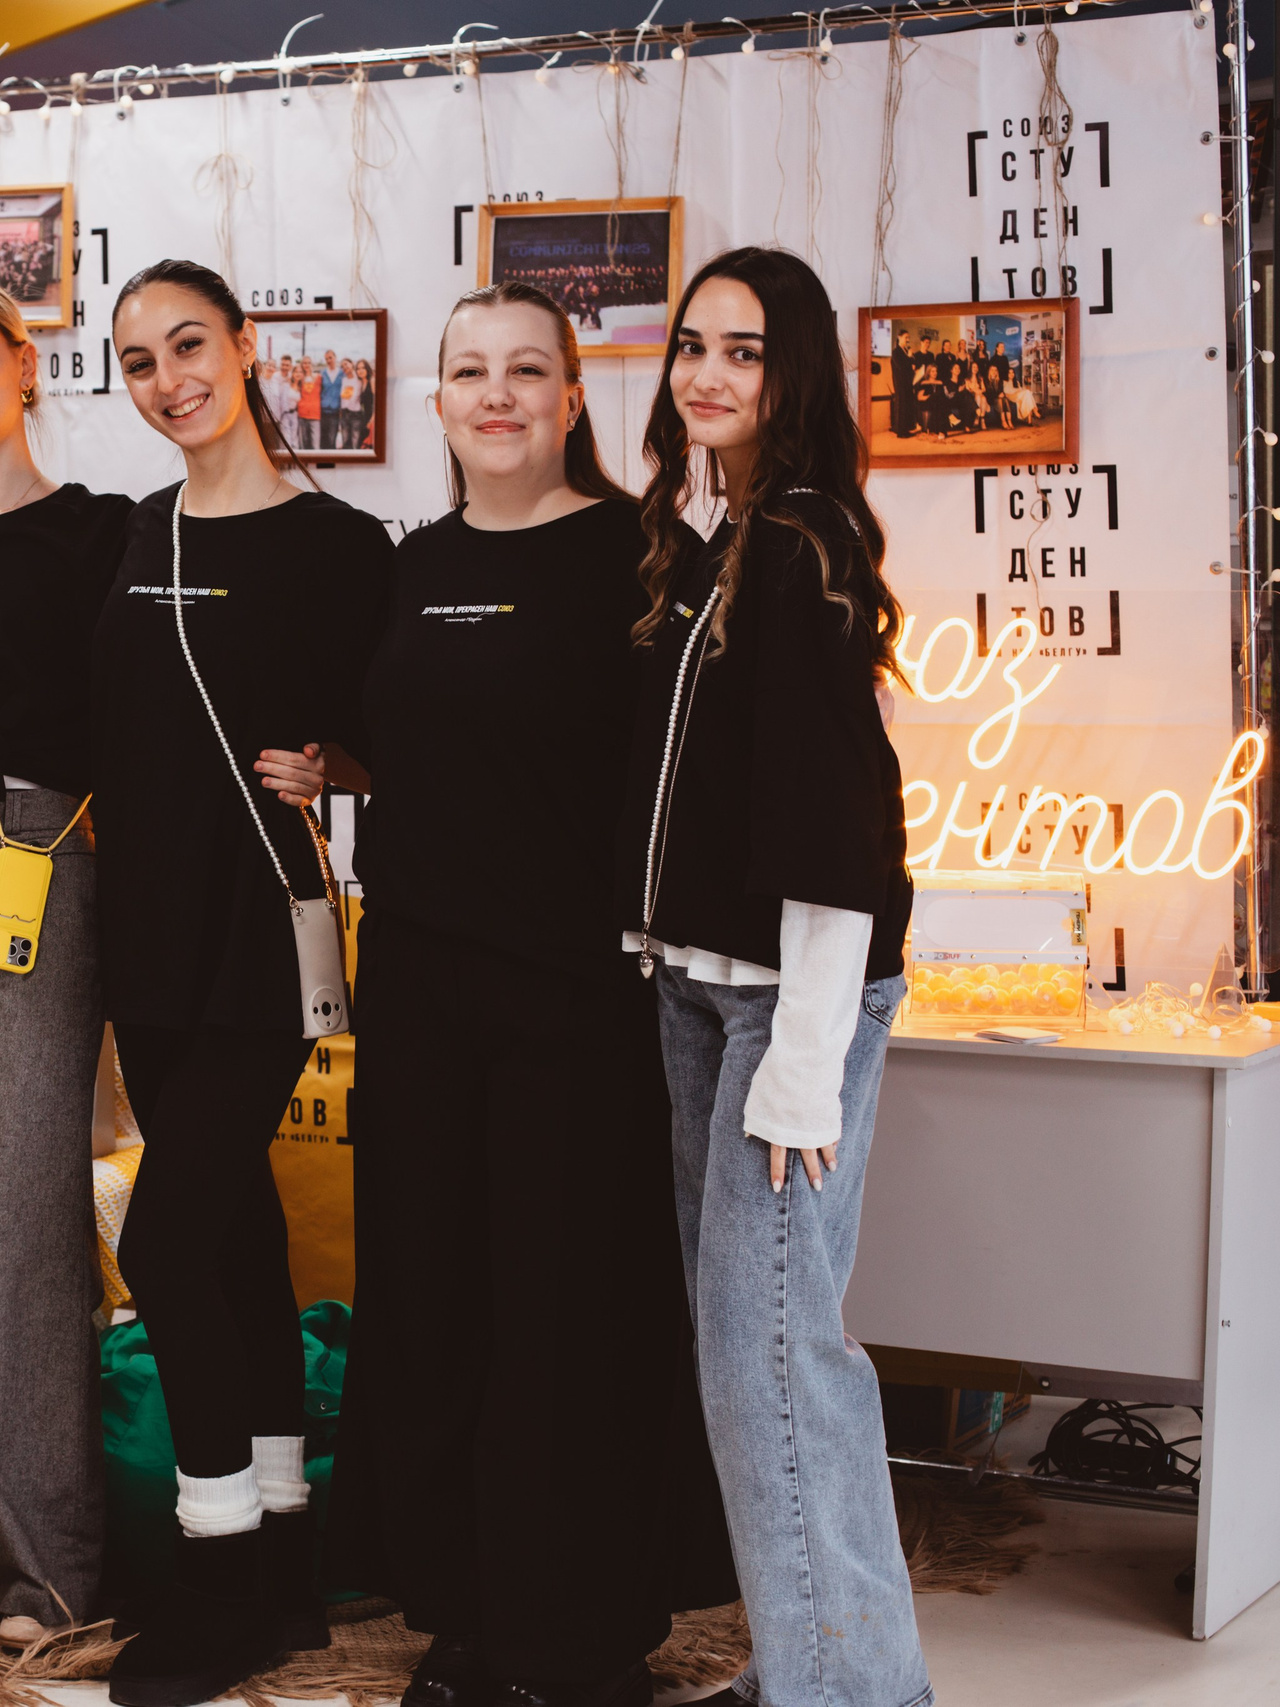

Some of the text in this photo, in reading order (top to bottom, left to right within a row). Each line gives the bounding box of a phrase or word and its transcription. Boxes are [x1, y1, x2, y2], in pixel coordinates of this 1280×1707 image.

[1002, 114, 1071, 138] СОЮЗ
[1001, 146, 1074, 181] СТУ
[999, 205, 1078, 244] ДЕН
[251, 287, 303, 307] СОЮЗ
[1002, 265, 1078, 299] ТОВ
[1008, 488, 1082, 520] СТУ
[1008, 546, 1086, 583] ДЕН
[1011, 605, 1085, 637] ТОВ
